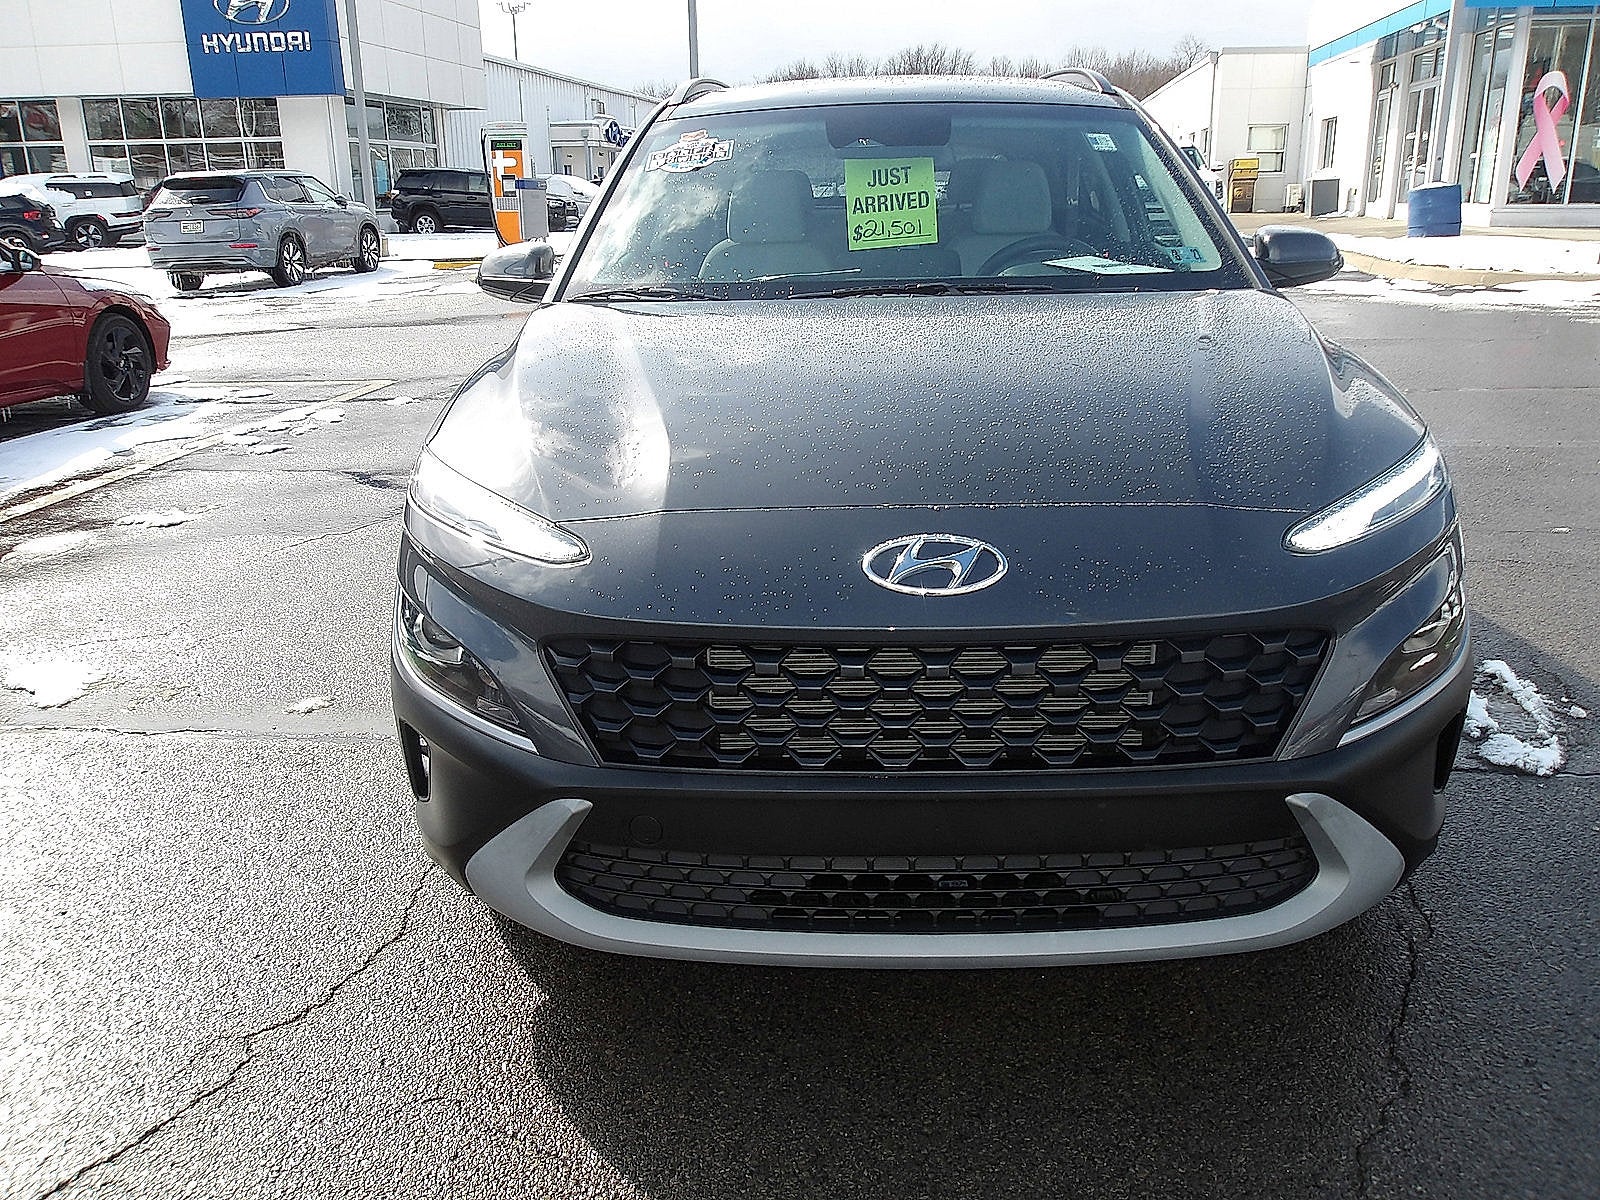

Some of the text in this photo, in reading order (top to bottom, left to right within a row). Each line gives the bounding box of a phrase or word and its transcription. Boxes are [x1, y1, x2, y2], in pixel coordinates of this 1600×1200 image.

[201, 30, 312, 54] HYUNDAI
[867, 165, 912, 188] JUST
[852, 190, 930, 215] ARRIVED
[852, 219, 922, 243] $21,501
